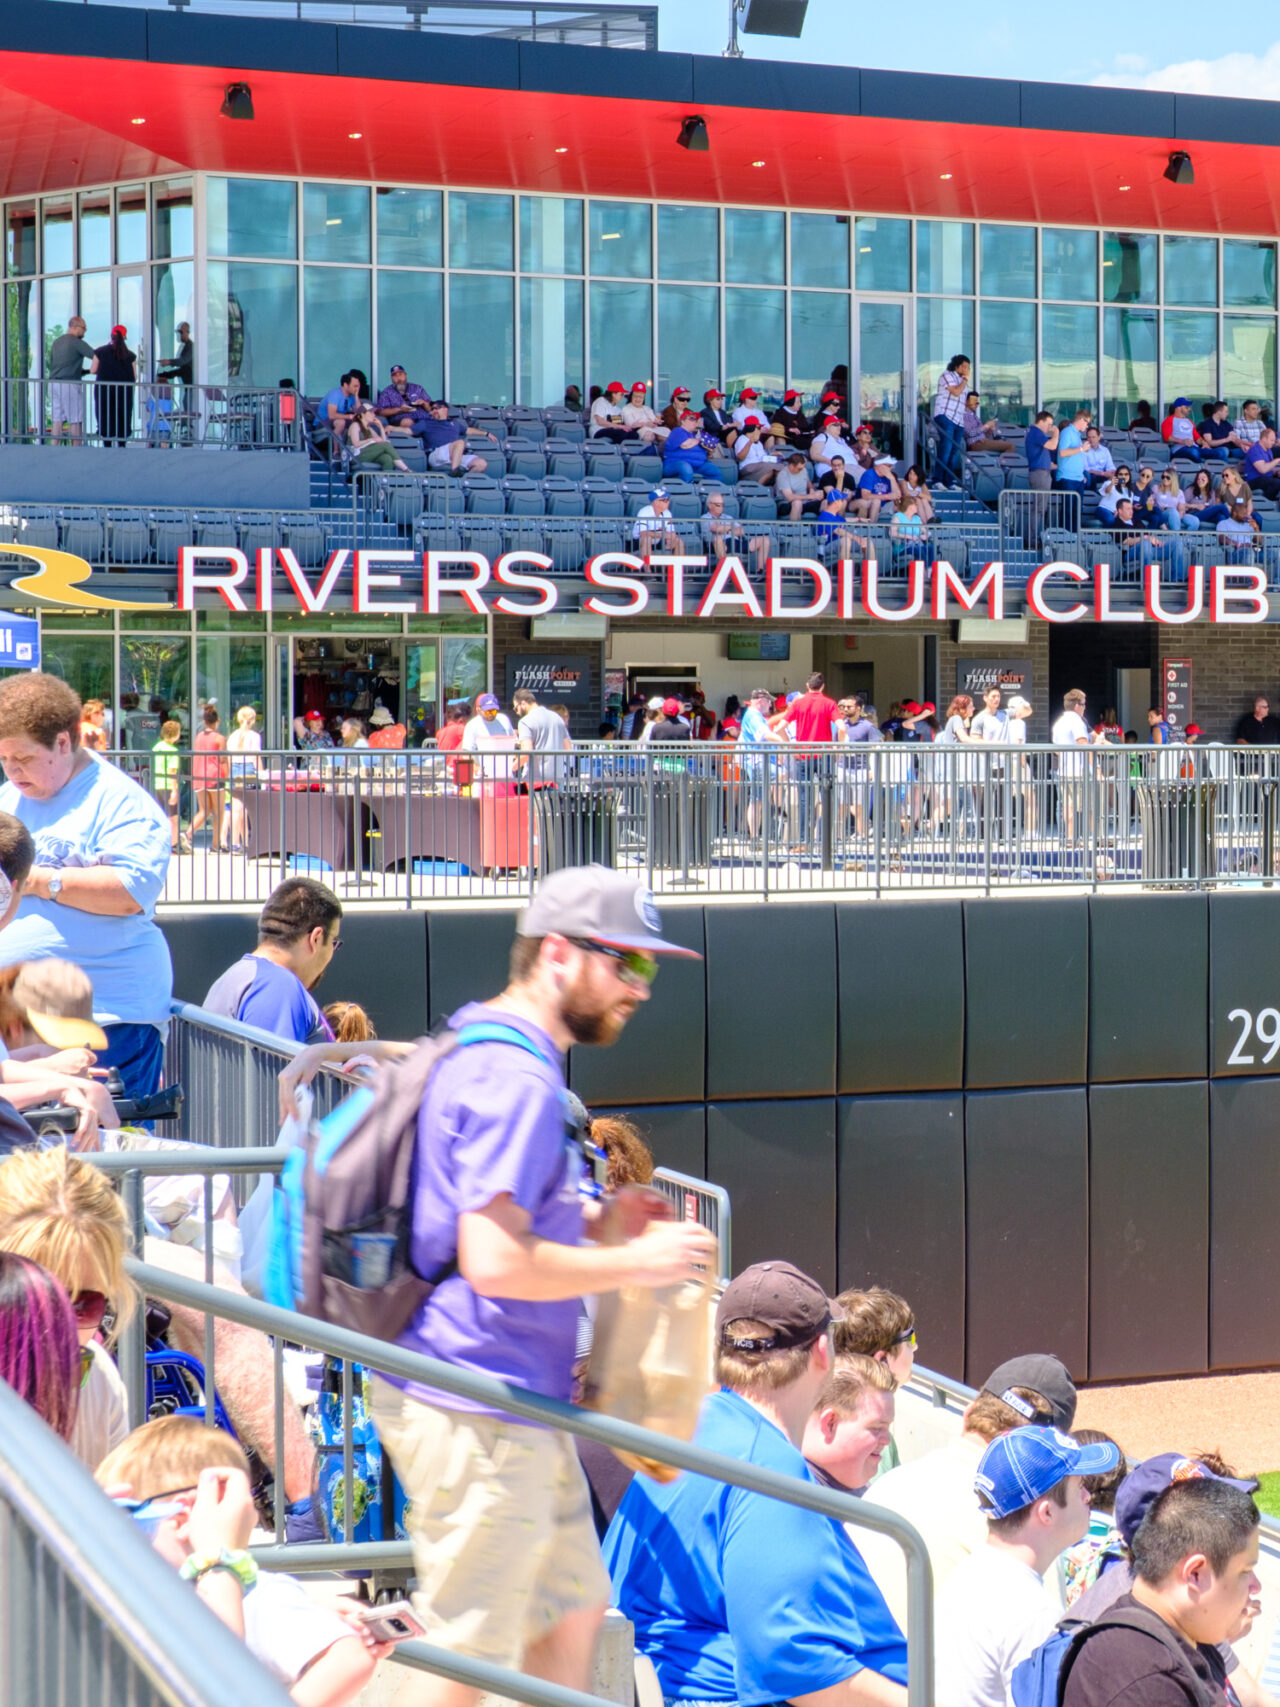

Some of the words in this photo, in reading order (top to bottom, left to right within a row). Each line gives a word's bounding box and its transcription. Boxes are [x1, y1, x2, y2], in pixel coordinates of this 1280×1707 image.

[177, 546, 558, 615] RIVERS
[585, 551, 1004, 621] STADIUM
[1027, 560, 1271, 624] CLUB
[515, 670, 581, 681] FLASHPOINT
[966, 673, 1025, 683] FLASHPOINT
[733, 1337, 754, 1349] NCIS
